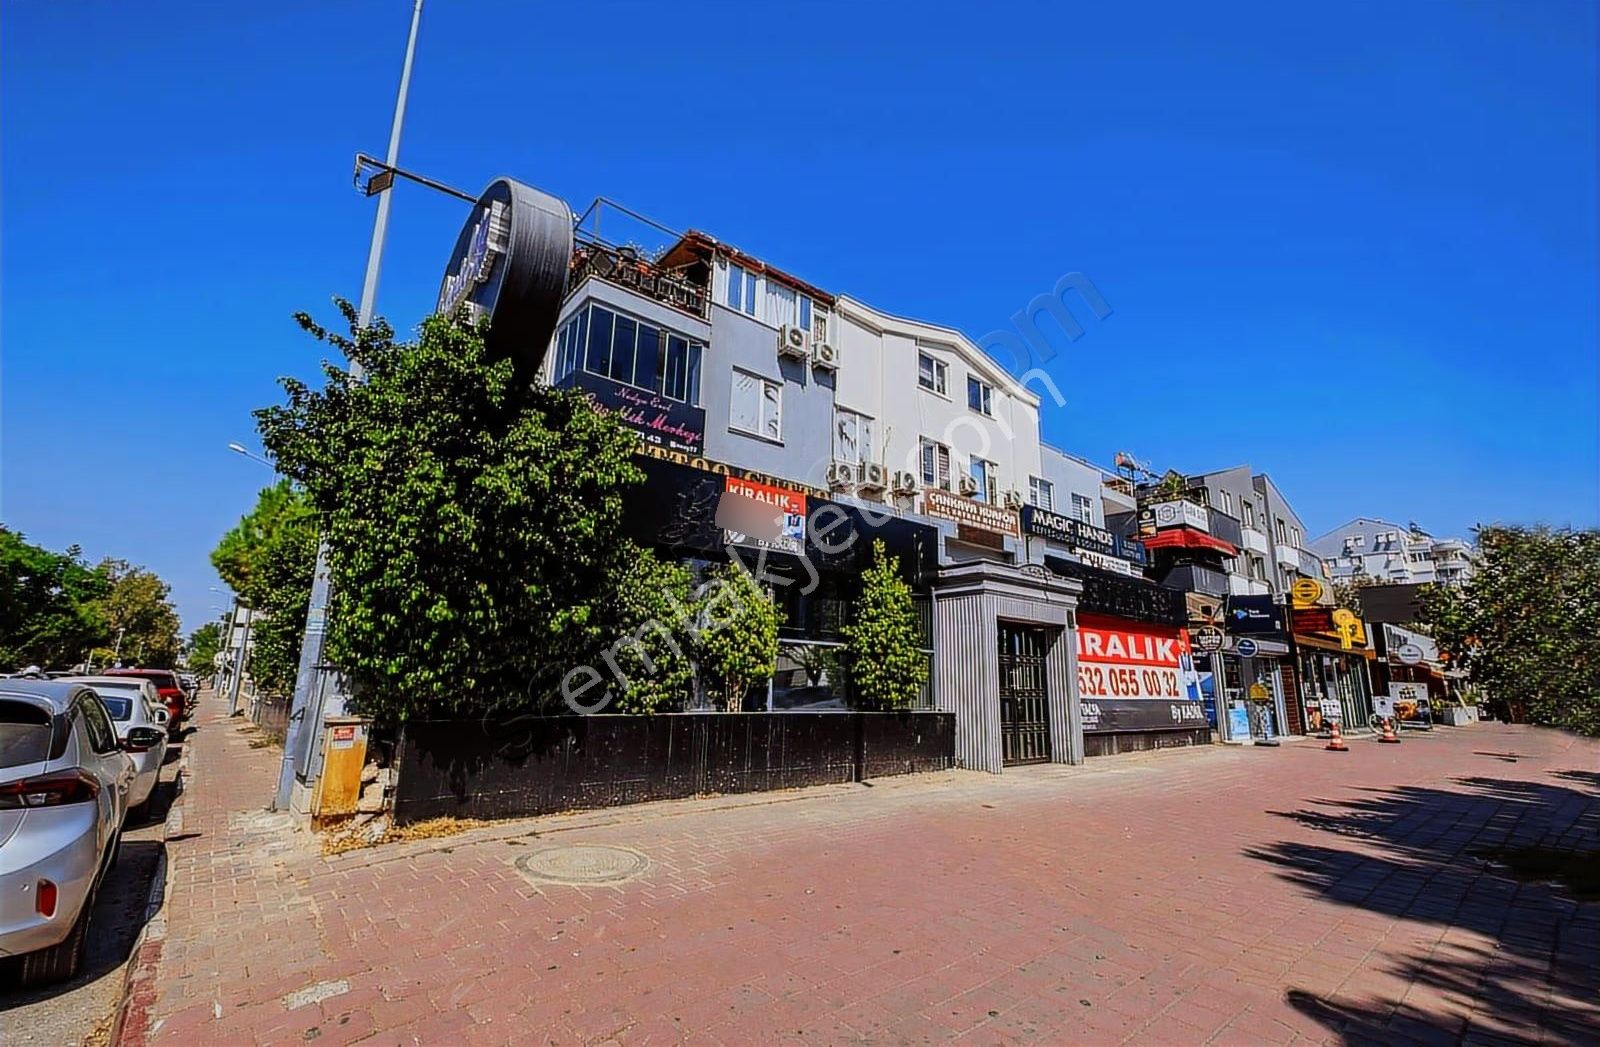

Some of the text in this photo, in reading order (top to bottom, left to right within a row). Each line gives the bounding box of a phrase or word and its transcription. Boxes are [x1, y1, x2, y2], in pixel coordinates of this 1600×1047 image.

[729, 482, 791, 509] KİRALIK
[1031, 509, 1074, 535] MAGIC
[1078, 523, 1114, 547] HANDS
[1109, 668, 1140, 697] 055
[1143, 669, 1162, 697] 00
[1163, 671, 1180, 697] 32
